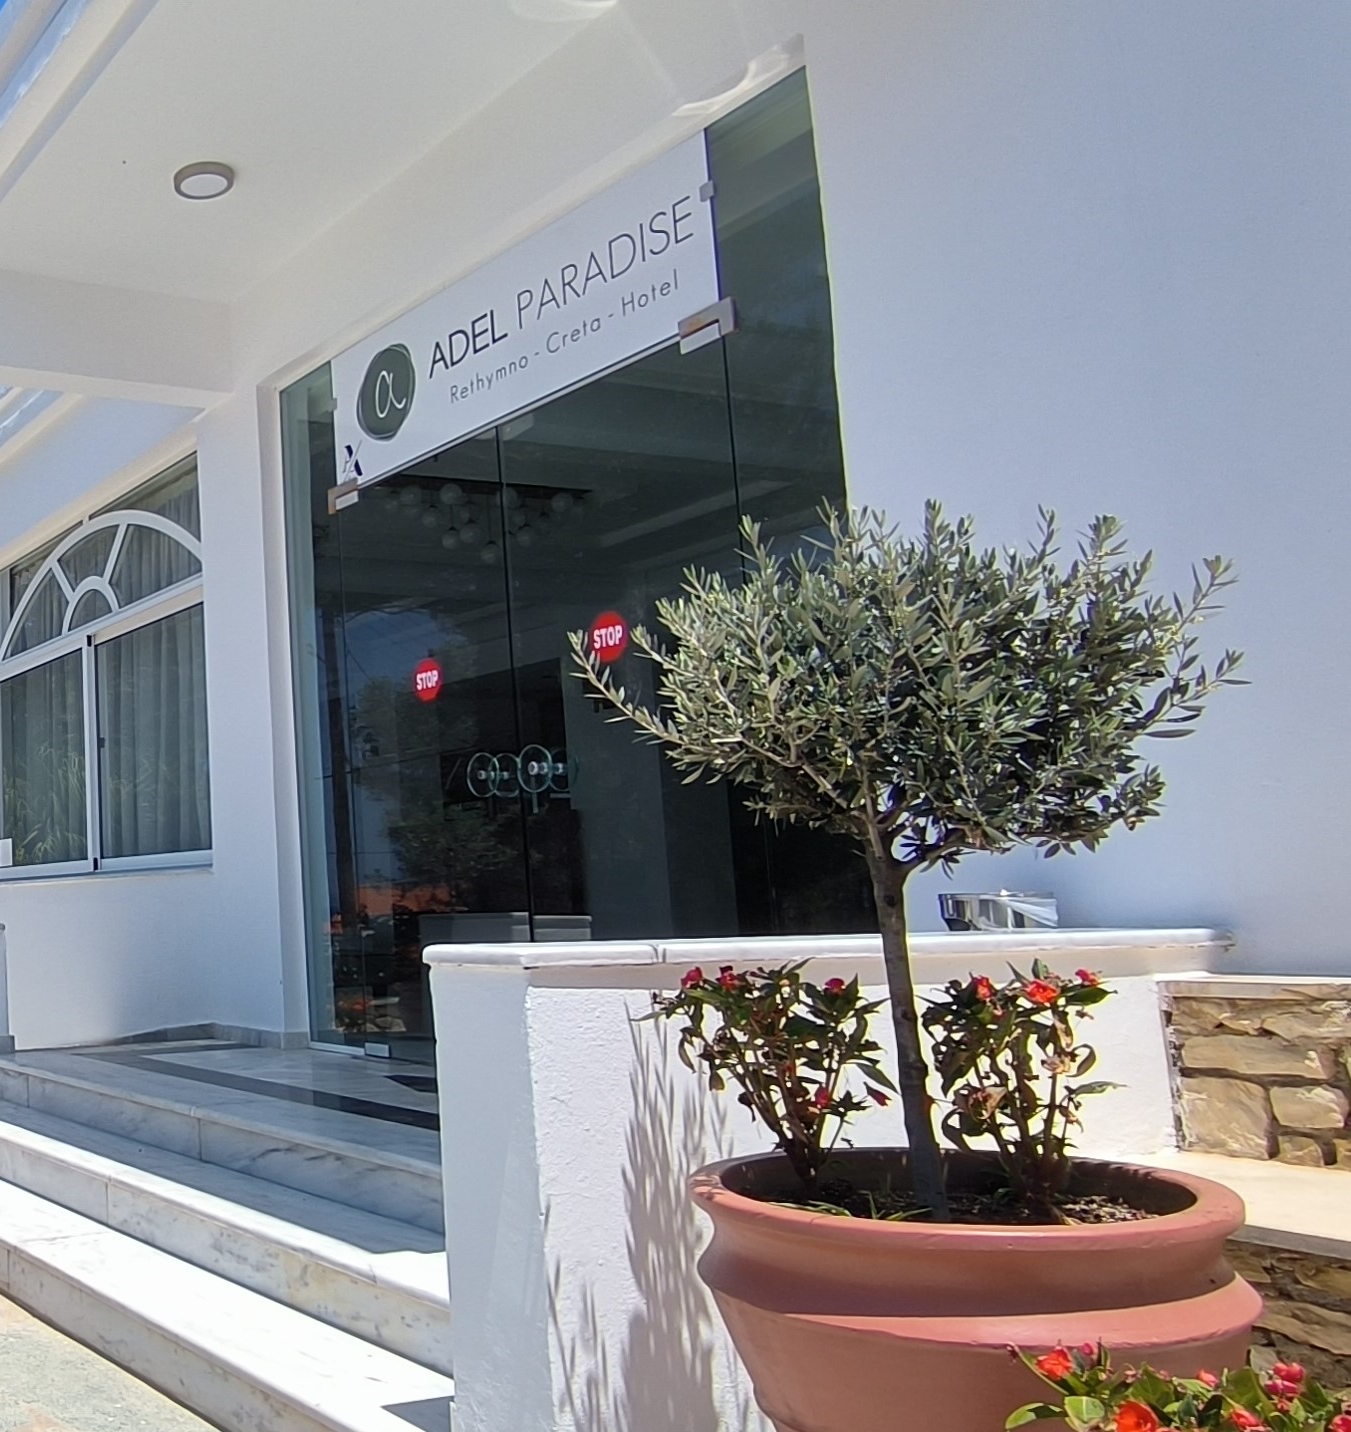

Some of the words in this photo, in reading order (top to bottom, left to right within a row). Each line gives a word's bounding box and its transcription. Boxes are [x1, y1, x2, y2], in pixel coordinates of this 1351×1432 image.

[428, 309, 508, 379] ADEL
[516, 195, 694, 330] PARADISE
[450, 353, 529, 404] Rethymno
[545, 316, 602, 355] Creta
[621, 268, 679, 318] Hotel
[593, 625, 623, 649] STOP
[416, 669, 439, 691] STOP
